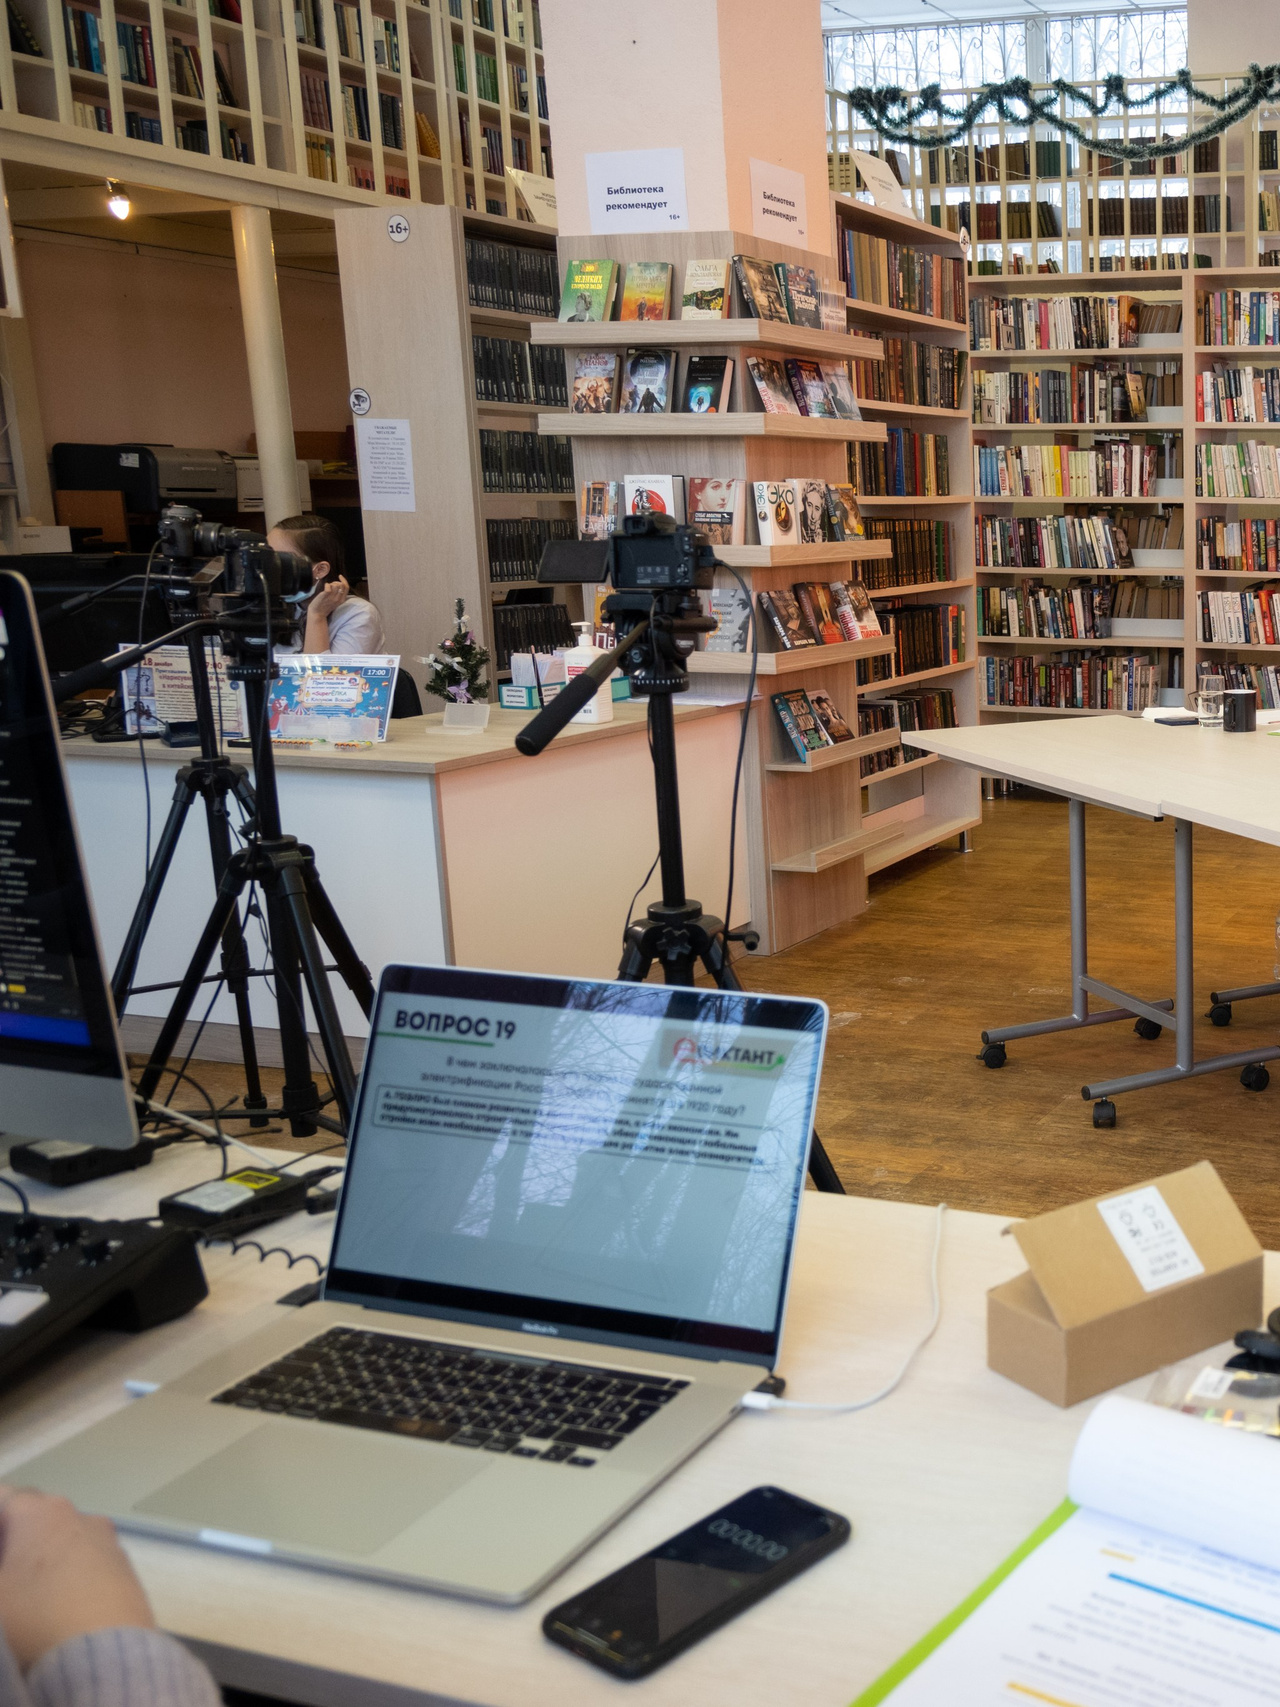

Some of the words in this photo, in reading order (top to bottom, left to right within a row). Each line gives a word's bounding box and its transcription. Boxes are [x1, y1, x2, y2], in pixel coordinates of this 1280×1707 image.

[607, 185, 664, 196] Библиотека
[762, 191, 796, 208] Библиотека
[605, 200, 668, 212] рекомендует
[762, 207, 798, 223] рекомендует
[389, 222, 409, 235] 16+
[694, 264, 718, 272] ОЛЬГА
[986, 405, 993, 417] К
[142, 657, 153, 666] 18
[395, 1010, 491, 1037] ВОПРОС
[496, 1020, 517, 1039] 19
